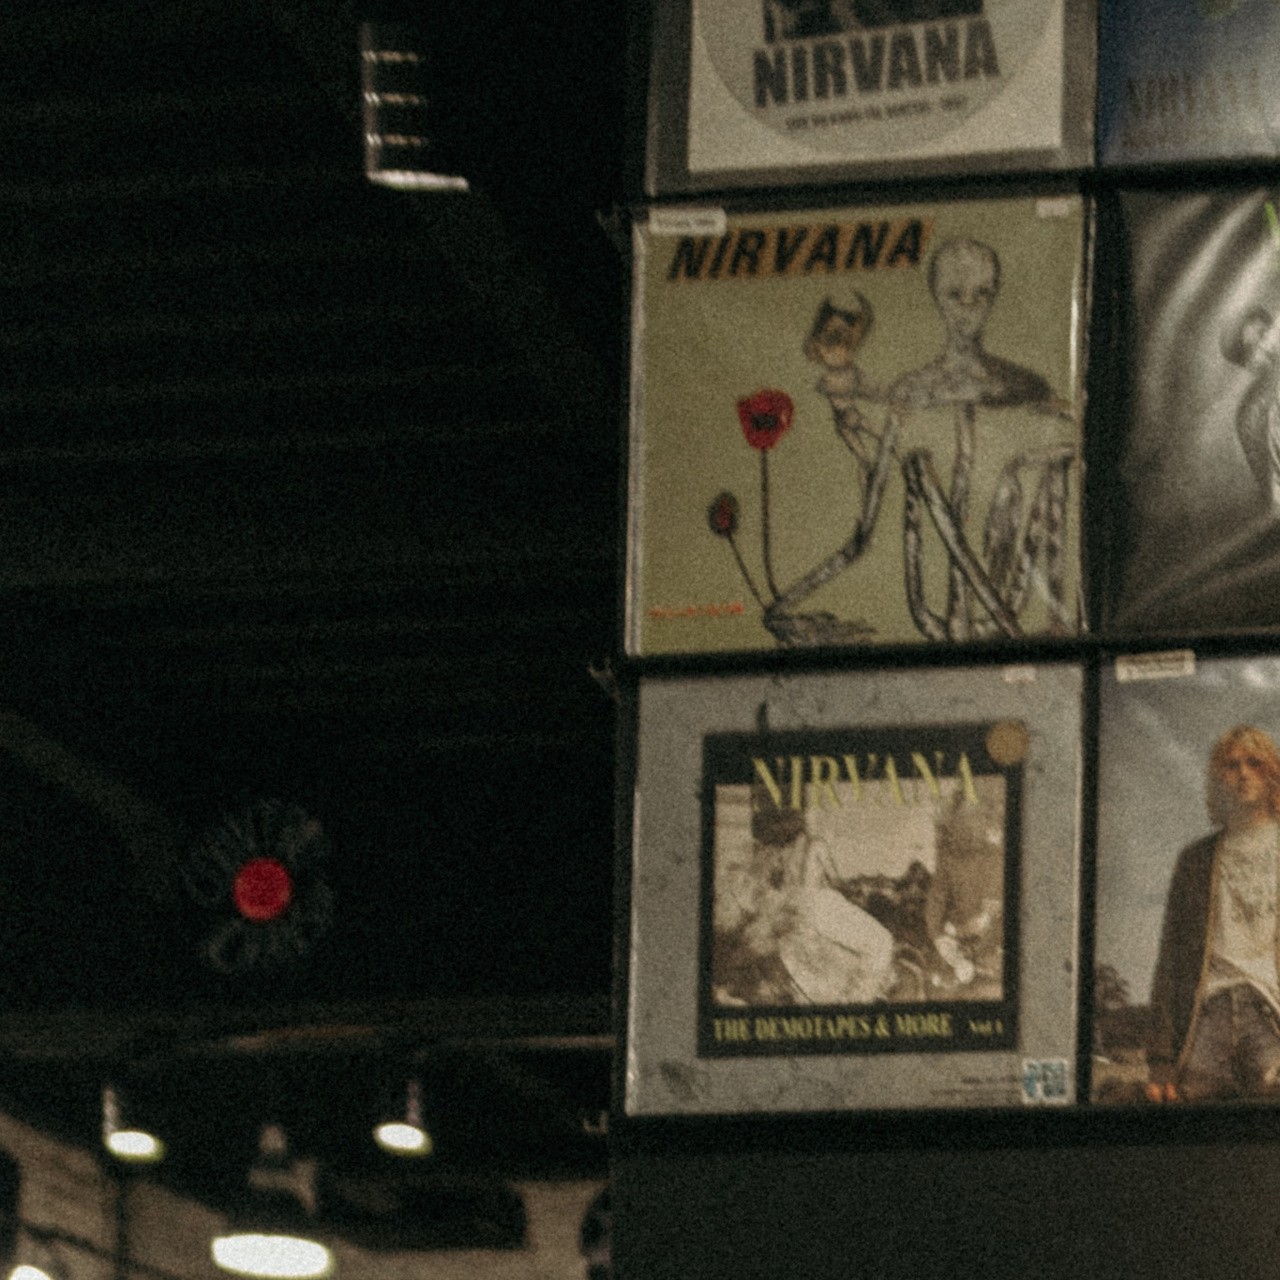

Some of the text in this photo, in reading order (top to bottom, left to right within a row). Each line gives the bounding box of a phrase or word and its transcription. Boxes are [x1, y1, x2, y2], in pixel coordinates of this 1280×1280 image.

[753, 18, 1000, 109] NIRVANA
[667, 219, 926, 282] NIRVANA
[752, 750, 979, 813] NIRVANA
[712, 1017, 751, 1042] THE
[754, 1013, 871, 1041] DEMOTAPES
[873, 1013, 891, 1039] &
[894, 1012, 954, 1038] MORE
